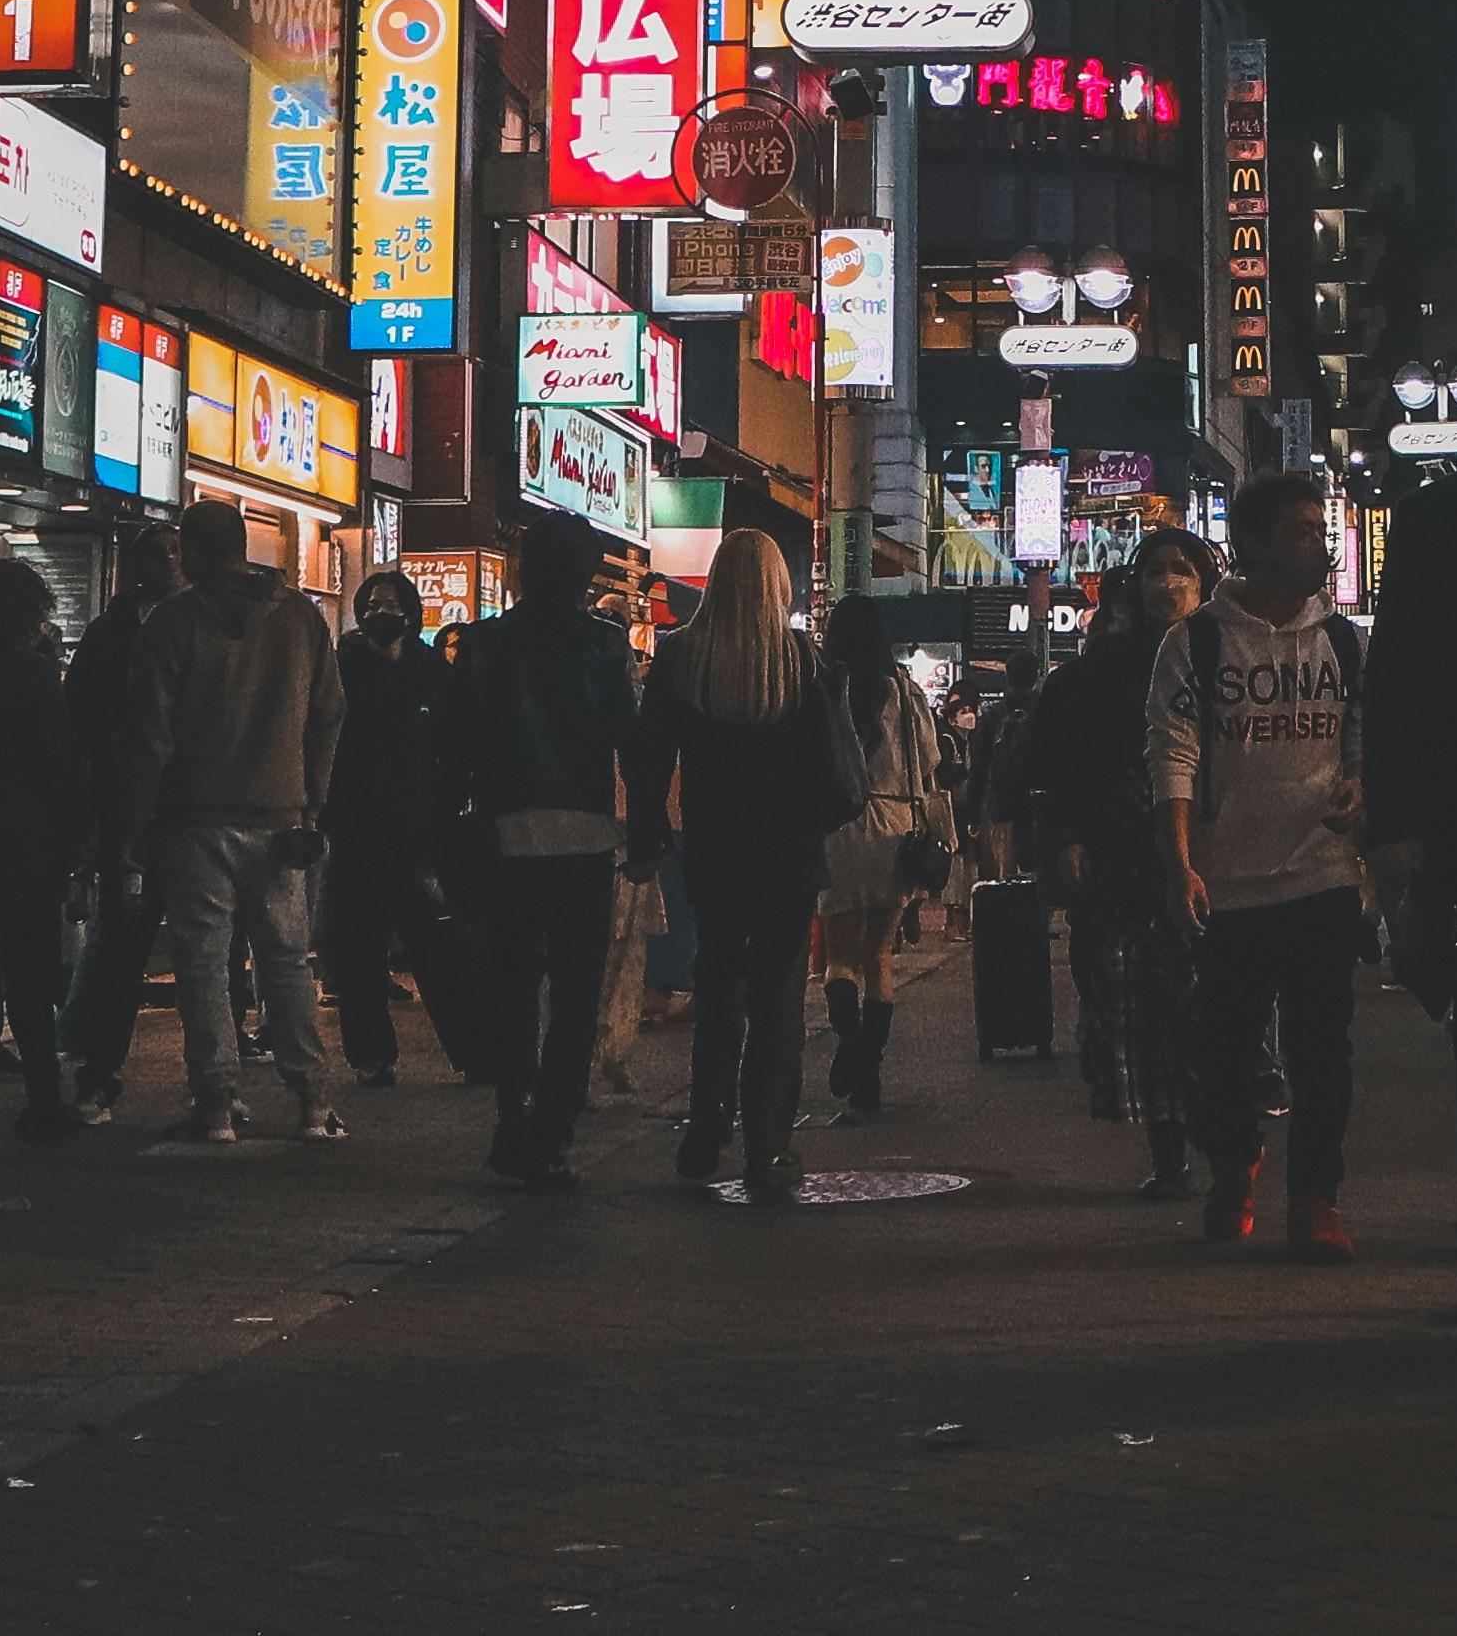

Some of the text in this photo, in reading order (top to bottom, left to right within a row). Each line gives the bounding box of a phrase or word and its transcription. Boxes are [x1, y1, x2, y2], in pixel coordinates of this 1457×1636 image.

[795, 0, 1016, 32] 渋谷センター街
[377, 74, 437, 196] 松屋
[708, 119, 775, 135] FIRE HYDRANT
[702, 136, 787, 180] 消火栓
[394, 225, 411, 282] カレー
[414, 216, 433, 273] 牛めし
[766, 241, 802, 258] 渋谷
[373, 238, 392, 291] 定食
[823, 247, 861, 278] Enjoy
[380, 302, 424, 320] 24h
[386, 326, 416, 344] 1F
[524, 338, 612, 361] Miami
[539, 368, 634, 401] garden
[400, 559, 469, 575] ラオケルーム
